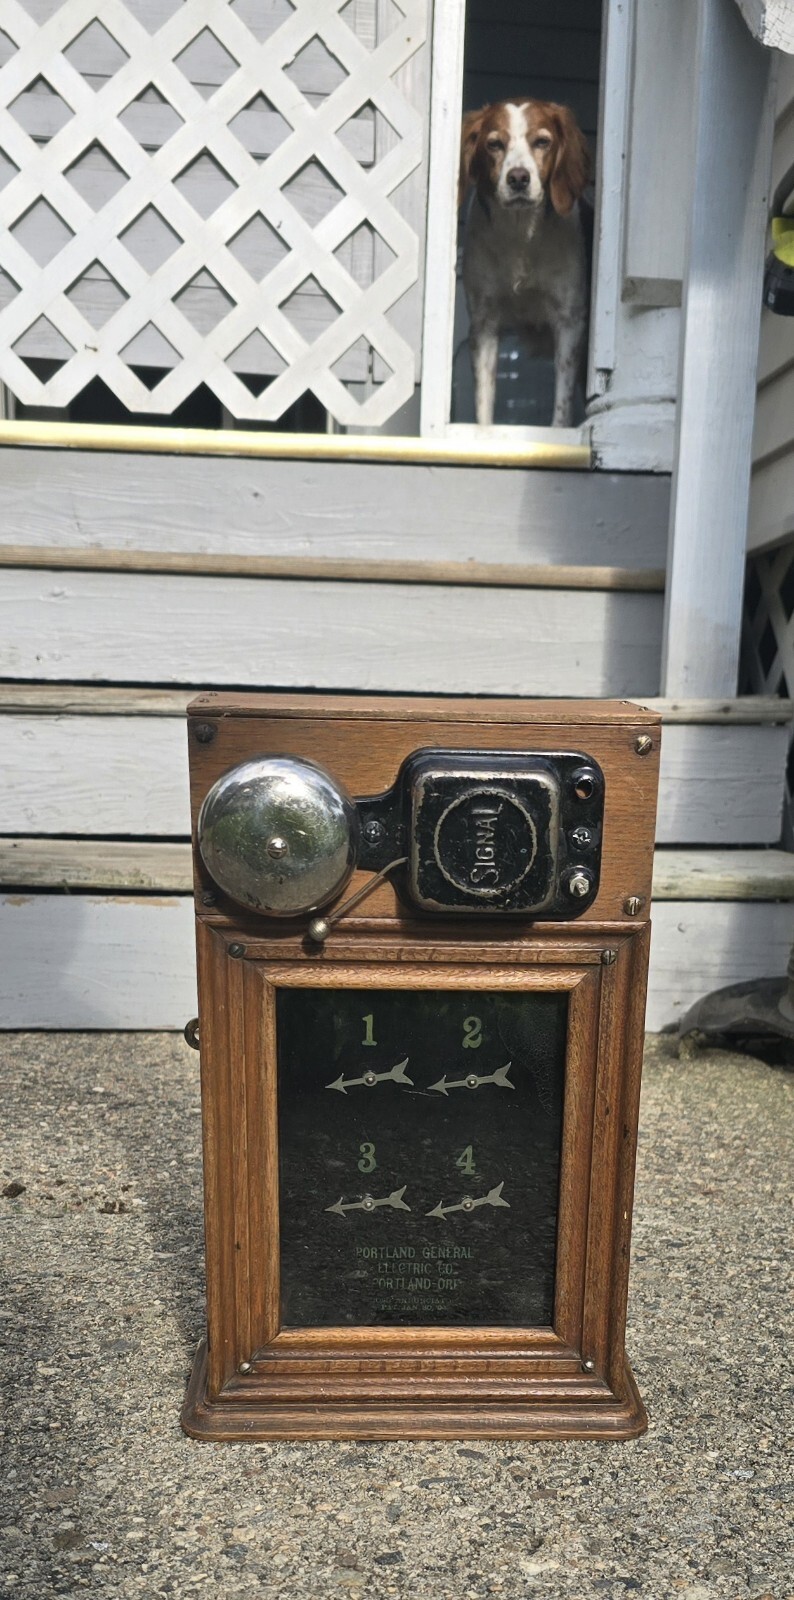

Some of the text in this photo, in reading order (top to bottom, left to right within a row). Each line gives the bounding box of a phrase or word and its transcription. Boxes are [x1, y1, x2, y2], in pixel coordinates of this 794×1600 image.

[470, 803, 503, 884] SIGNAL
[361, 1014, 482, 1048] 1 2
[357, 1142, 476, 1174] 3 4
[355, 1246, 475, 1259] PORTLAND GENERAL
